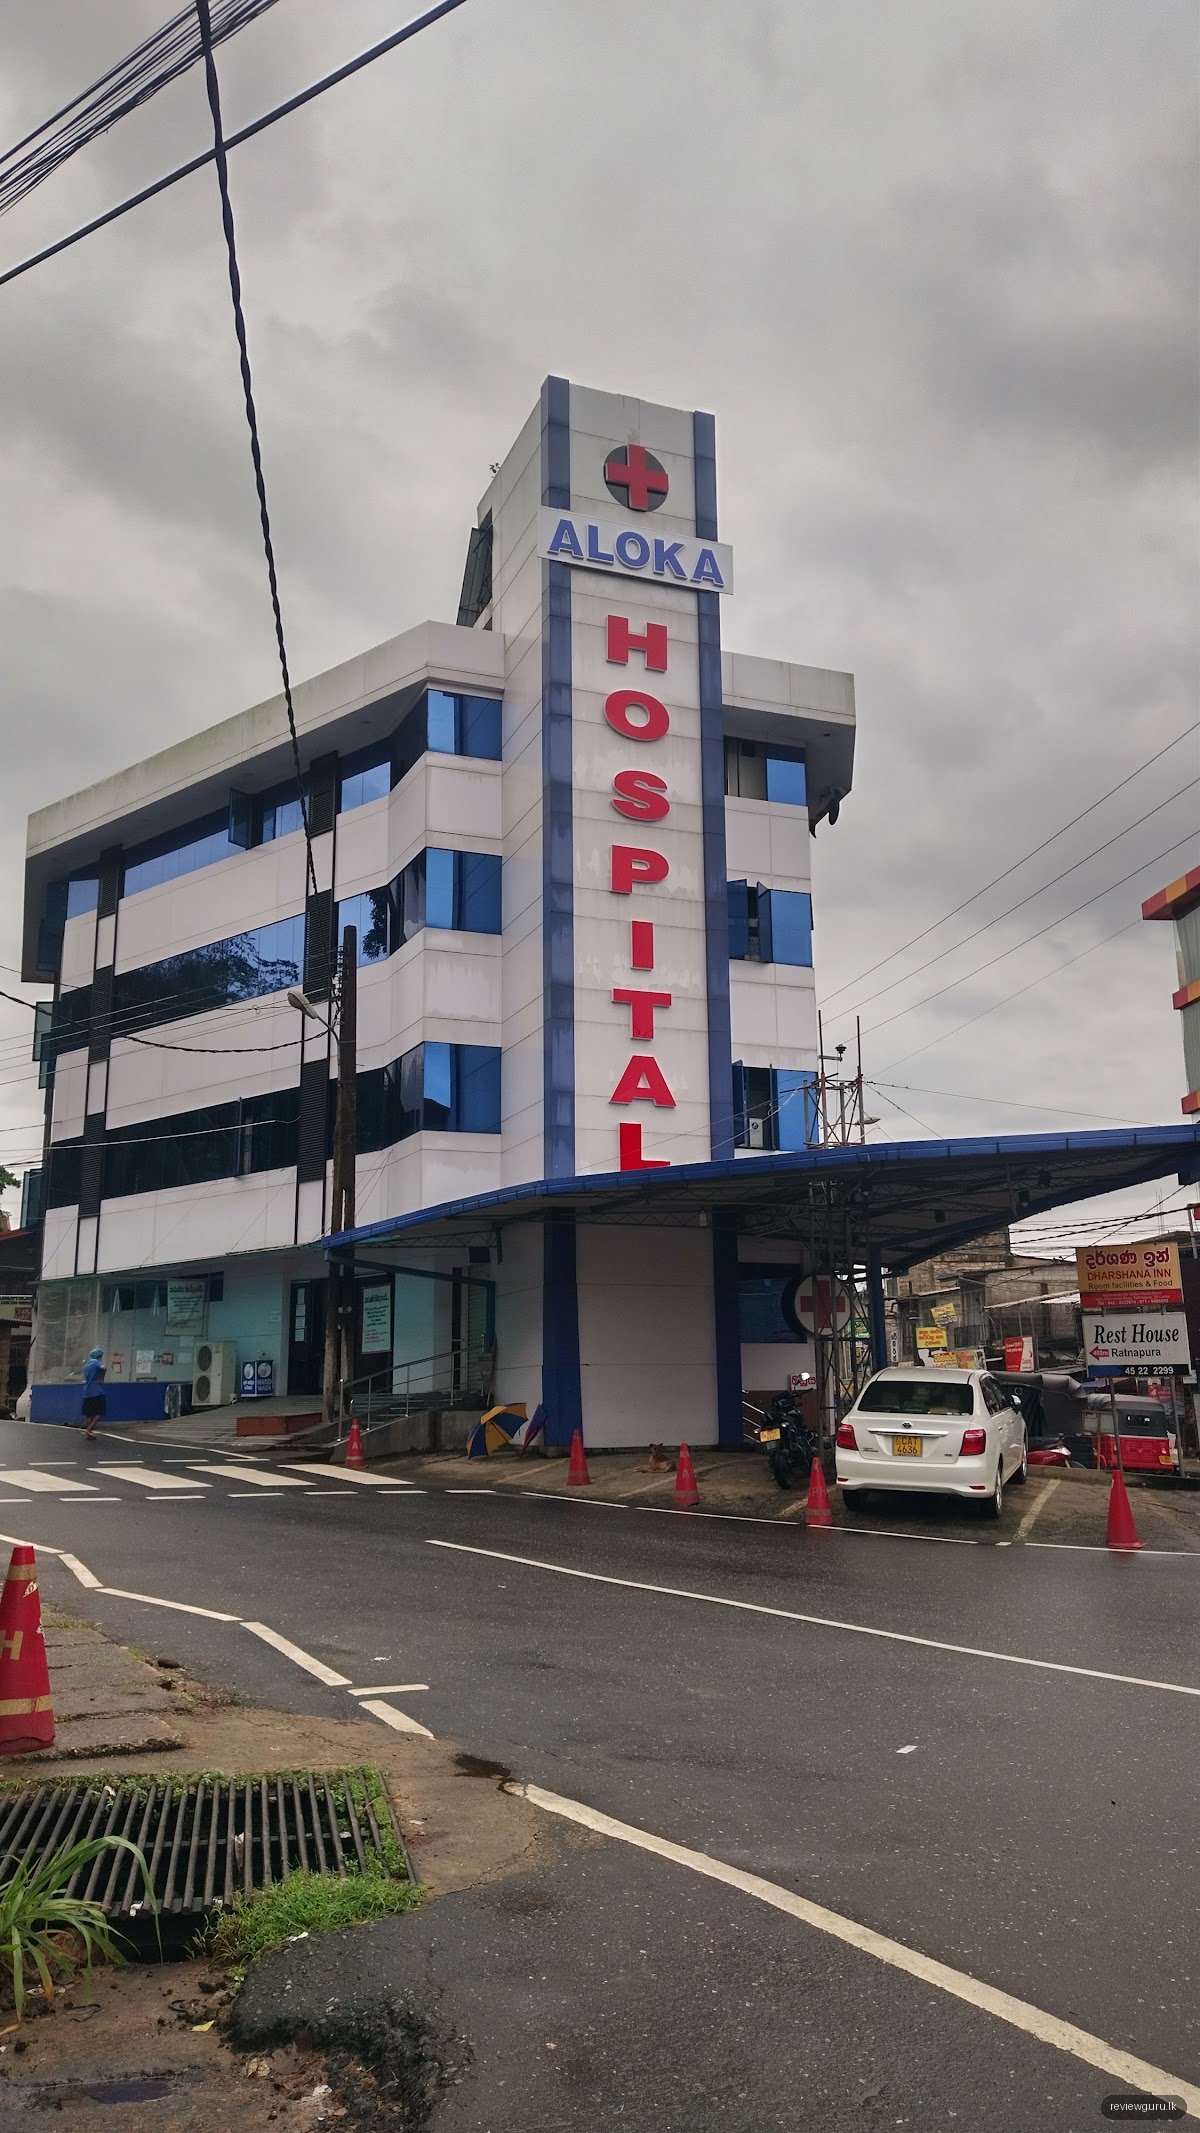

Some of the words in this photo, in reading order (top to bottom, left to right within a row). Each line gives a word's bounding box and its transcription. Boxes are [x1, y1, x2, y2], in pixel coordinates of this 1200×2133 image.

[547, 518, 725, 587] ALOKA
[605, 614, 677, 1171] HOSPITAL
[1087, 1270, 1151, 1281] DHARSHANA
[1153, 1269, 1171, 1278] INN
[1088, 1282, 1110, 1290] Room
[1112, 1281, 1143, 1289] facilities
[1094, 1324, 1126, 1344] Rest
[1131, 1323, 1179, 1343] House
[1111, 1348, 1161, 1359] Ratnapura
[1124, 1367, 1136, 1375] 45
[1137, 1366, 1149, 1375] 22
[1153, 1366, 1174, 1374] 2299
[901, 1436, 918, 1445] CAT
[897, 1445, 918, 1454] 4636
